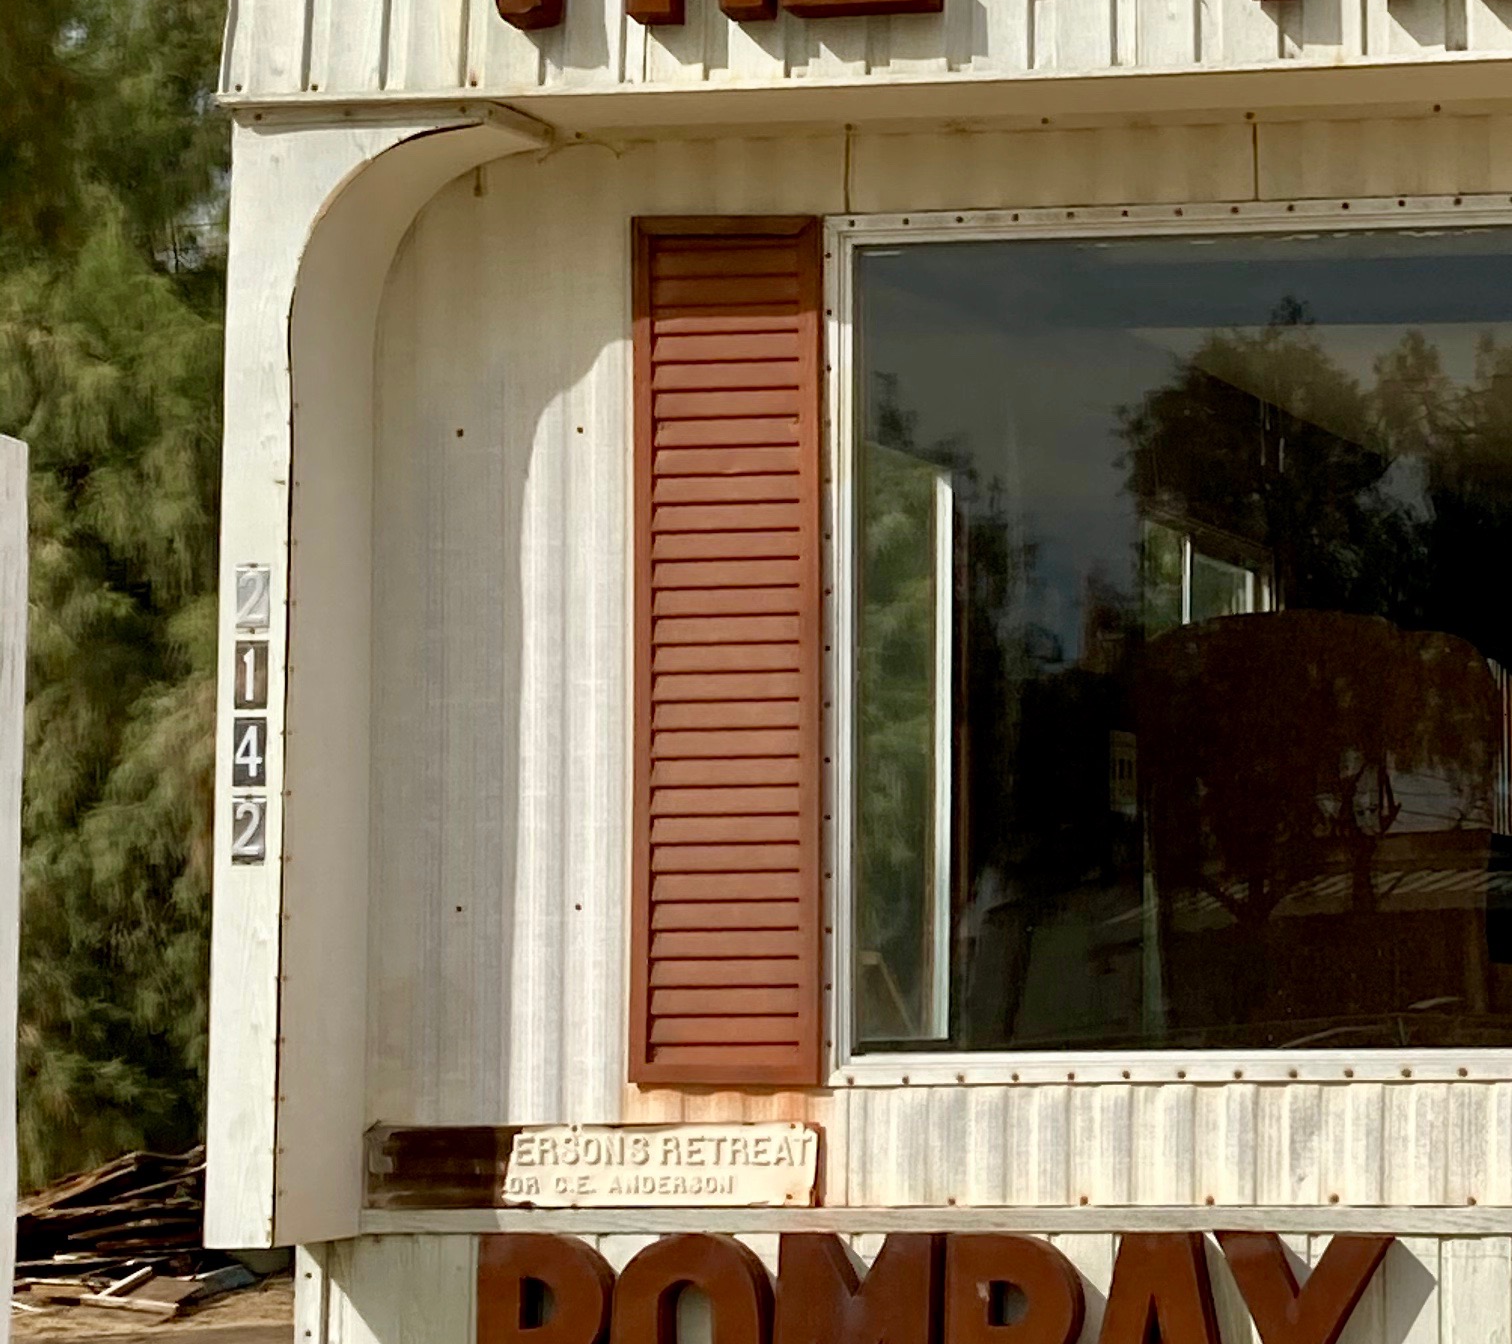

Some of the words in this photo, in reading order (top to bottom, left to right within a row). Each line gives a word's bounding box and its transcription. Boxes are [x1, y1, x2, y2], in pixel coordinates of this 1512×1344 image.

[231, 568, 271, 859] 2142
[660, 1134, 813, 1167] RETREAT
[608, 1174, 735, 1195] ANDERSON
